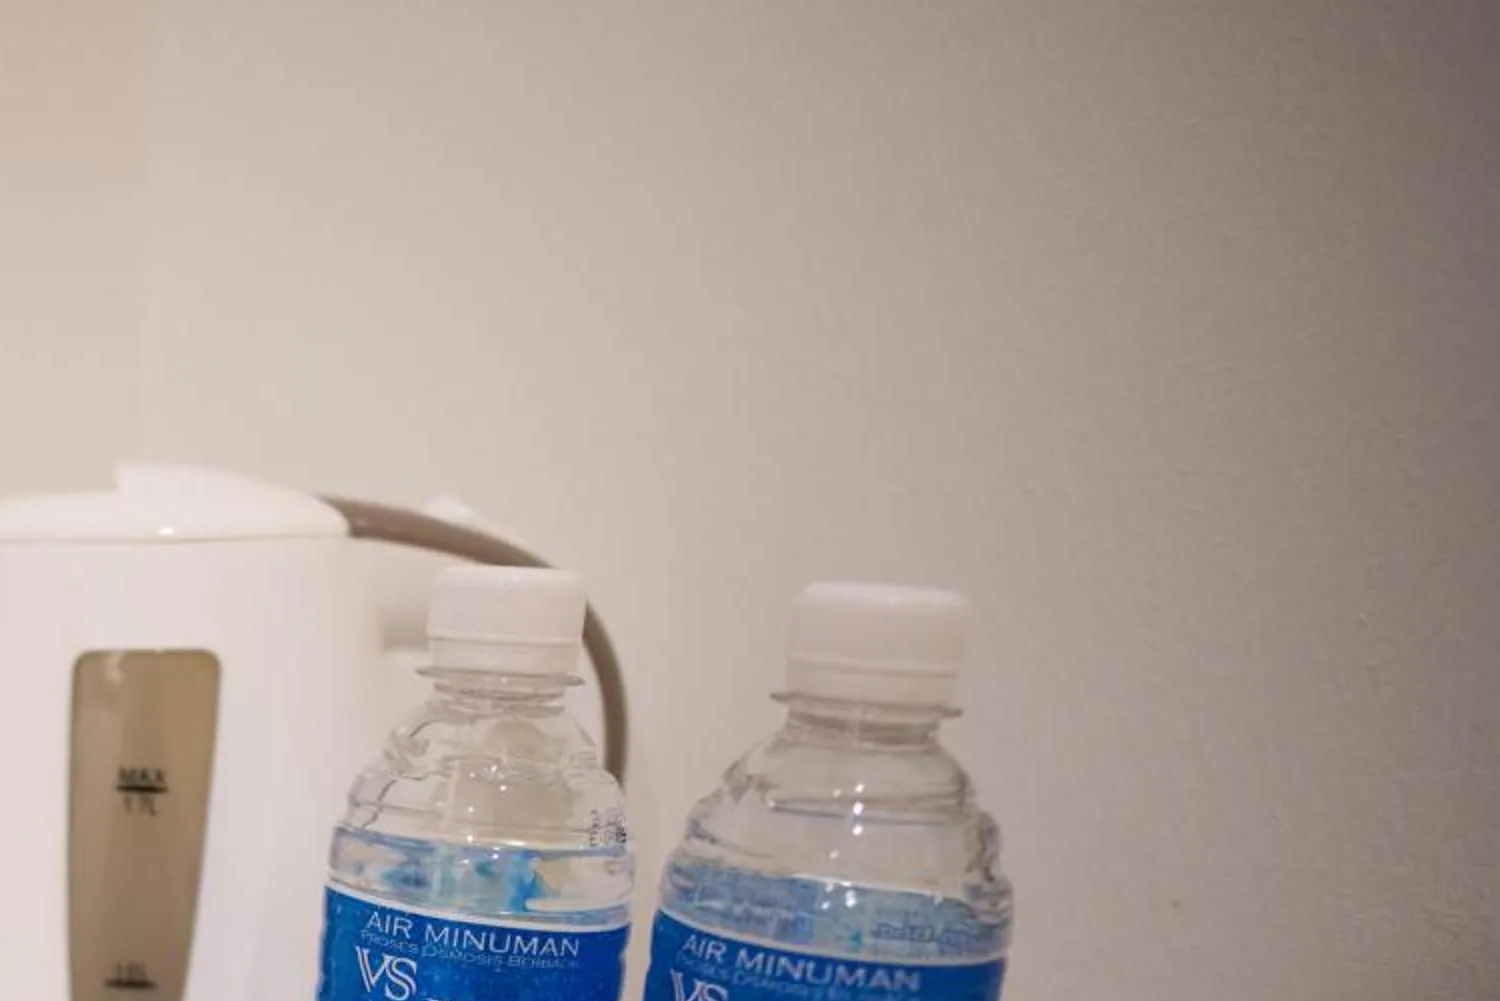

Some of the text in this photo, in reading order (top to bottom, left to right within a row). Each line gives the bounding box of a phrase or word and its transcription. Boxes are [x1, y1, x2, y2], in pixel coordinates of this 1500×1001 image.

[118, 766, 167, 786] MAX
[366, 911, 580, 957] AIR MINUMAN
[355, 945, 418, 1001] VS
[682, 934, 921, 992] AIR MINUMAN
